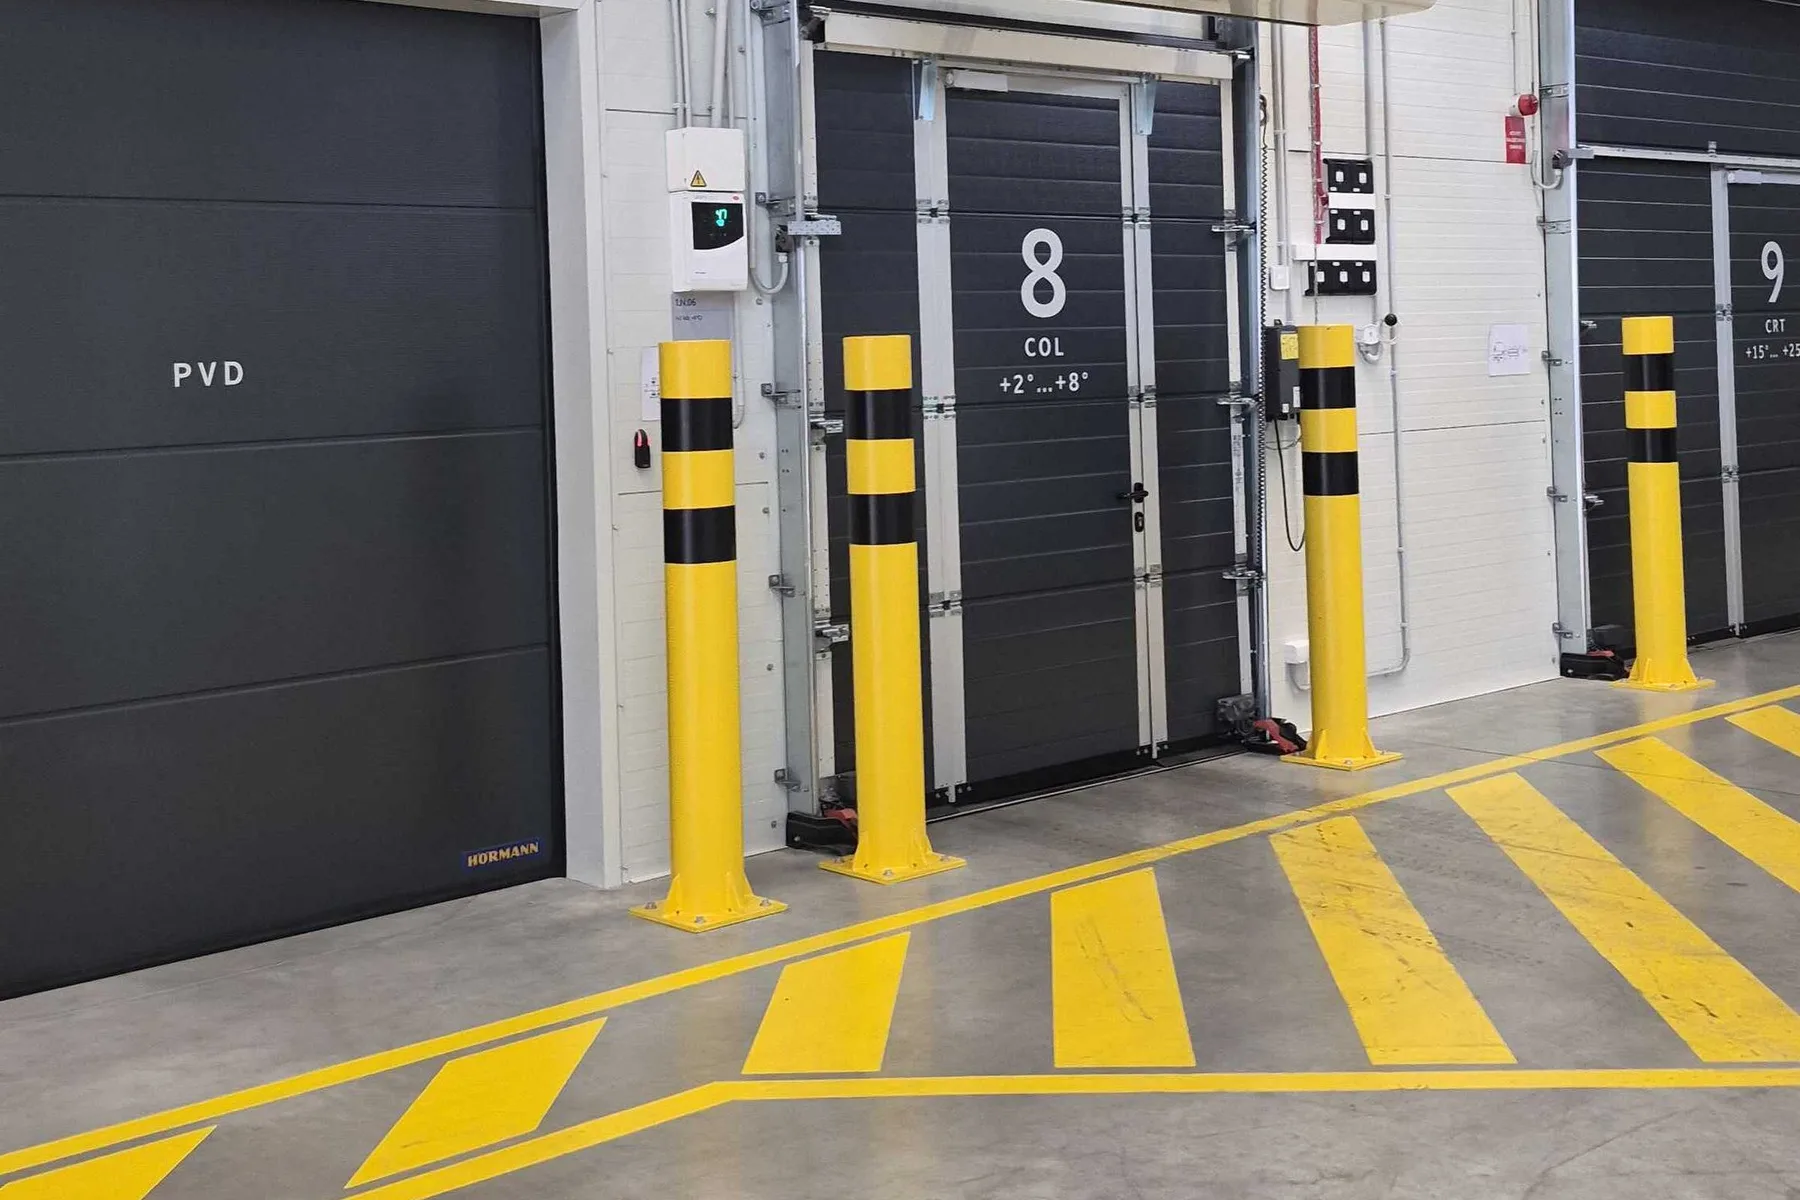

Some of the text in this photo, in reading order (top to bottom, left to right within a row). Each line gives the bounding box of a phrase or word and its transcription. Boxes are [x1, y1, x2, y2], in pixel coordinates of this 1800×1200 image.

[1021, 227, 1067, 318] 8
[1761, 241, 1785, 303] 9
[1765, 318, 1786, 333] CRT
[1024, 336, 1065, 357] COL
[173, 360, 244, 388] PVD
